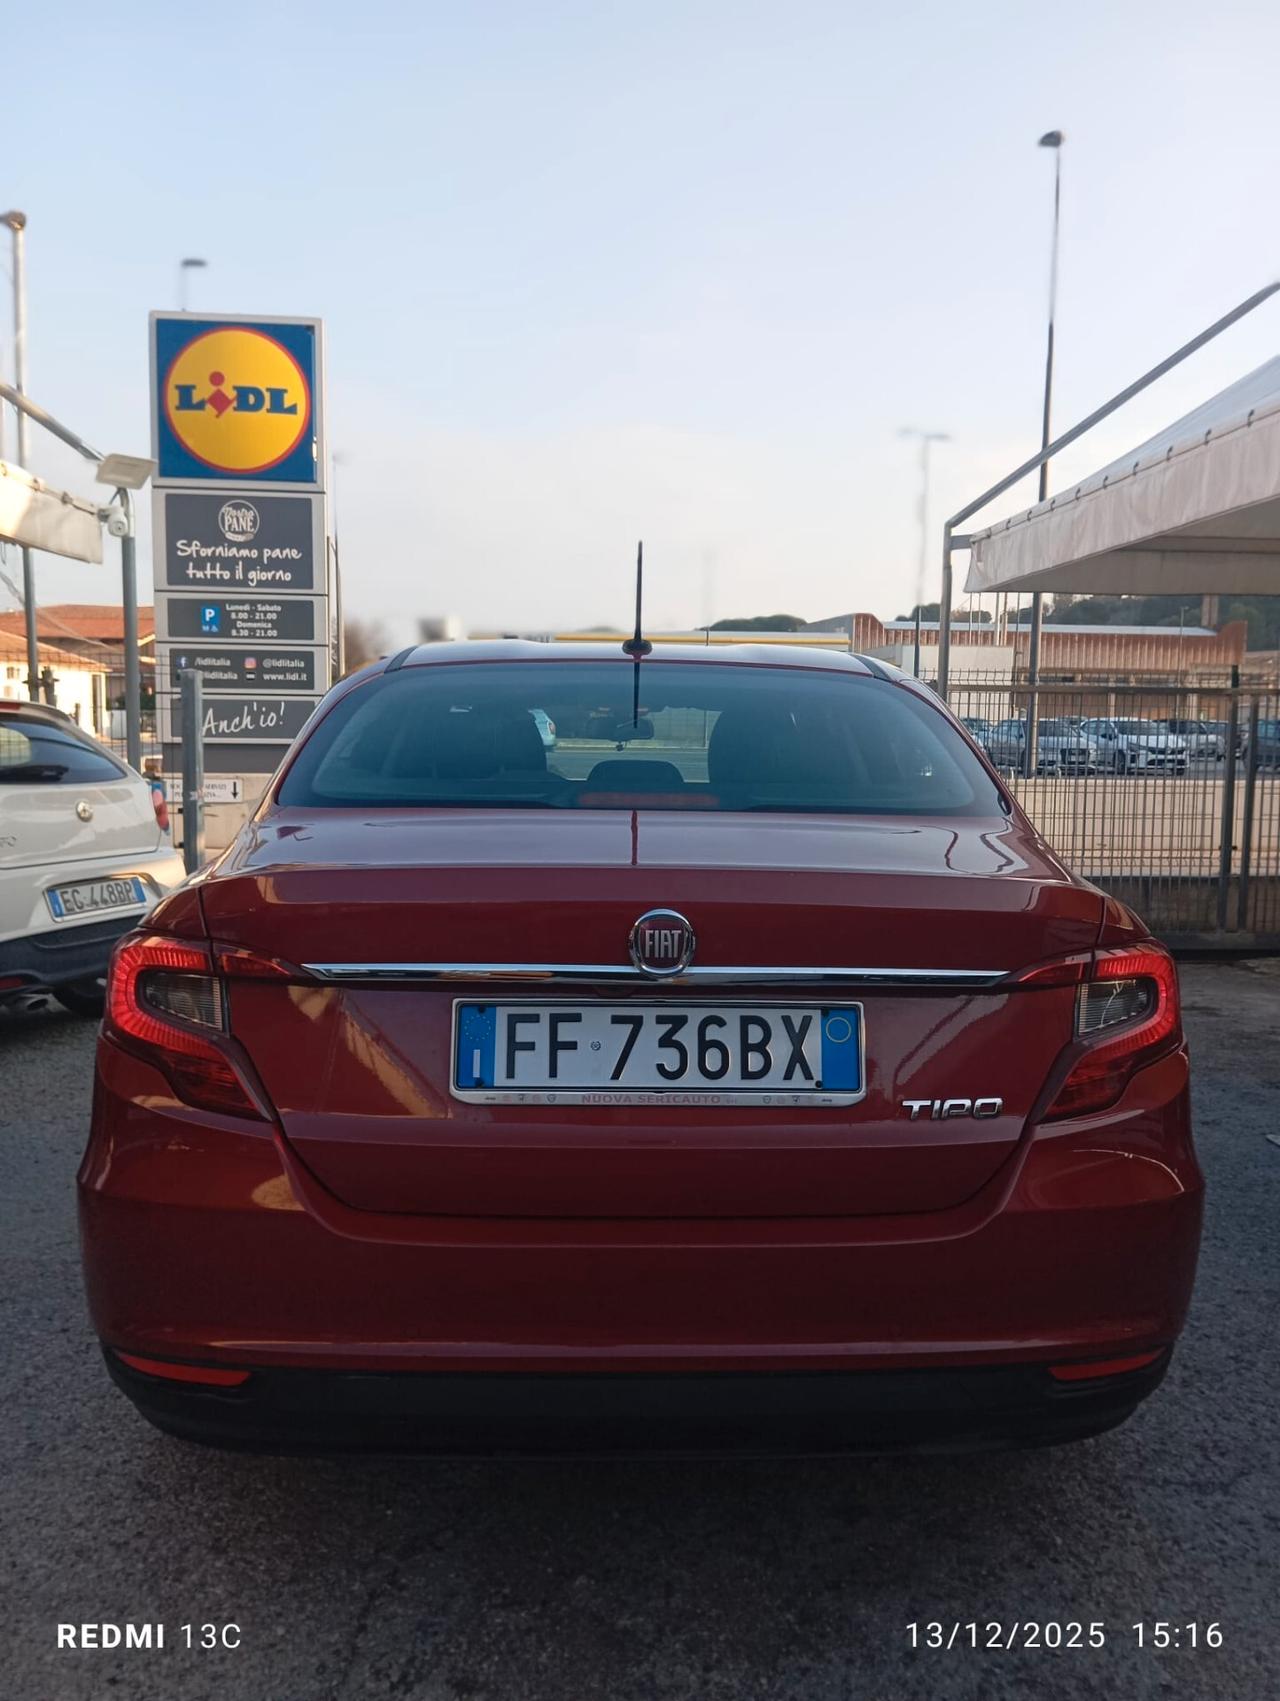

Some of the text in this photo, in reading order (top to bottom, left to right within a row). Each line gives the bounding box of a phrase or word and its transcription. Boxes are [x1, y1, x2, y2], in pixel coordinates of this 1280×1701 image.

[224, 515, 255, 532] PANE
[176, 539, 302, 564] Sforniamo pane
[186, 560, 292, 587] tutto il giorno
[257, 603, 282, 612] Sabato
[205, 608, 215, 621] P
[236, 620, 272, 629] Domenica
[255, 629, 278, 637] 21.00
[262, 658, 305, 668] @lidlitalia
[262, 672, 307, 681] www.lidl.it
[645, 929, 682, 958] FIAT
[505, 1012, 814, 1082] FF 736BX
[581, 1094, 632, 1104] NUOVA
[638, 1095, 721, 1104] SERICAUTO
[902, 1097, 1004, 1120] TIPO
